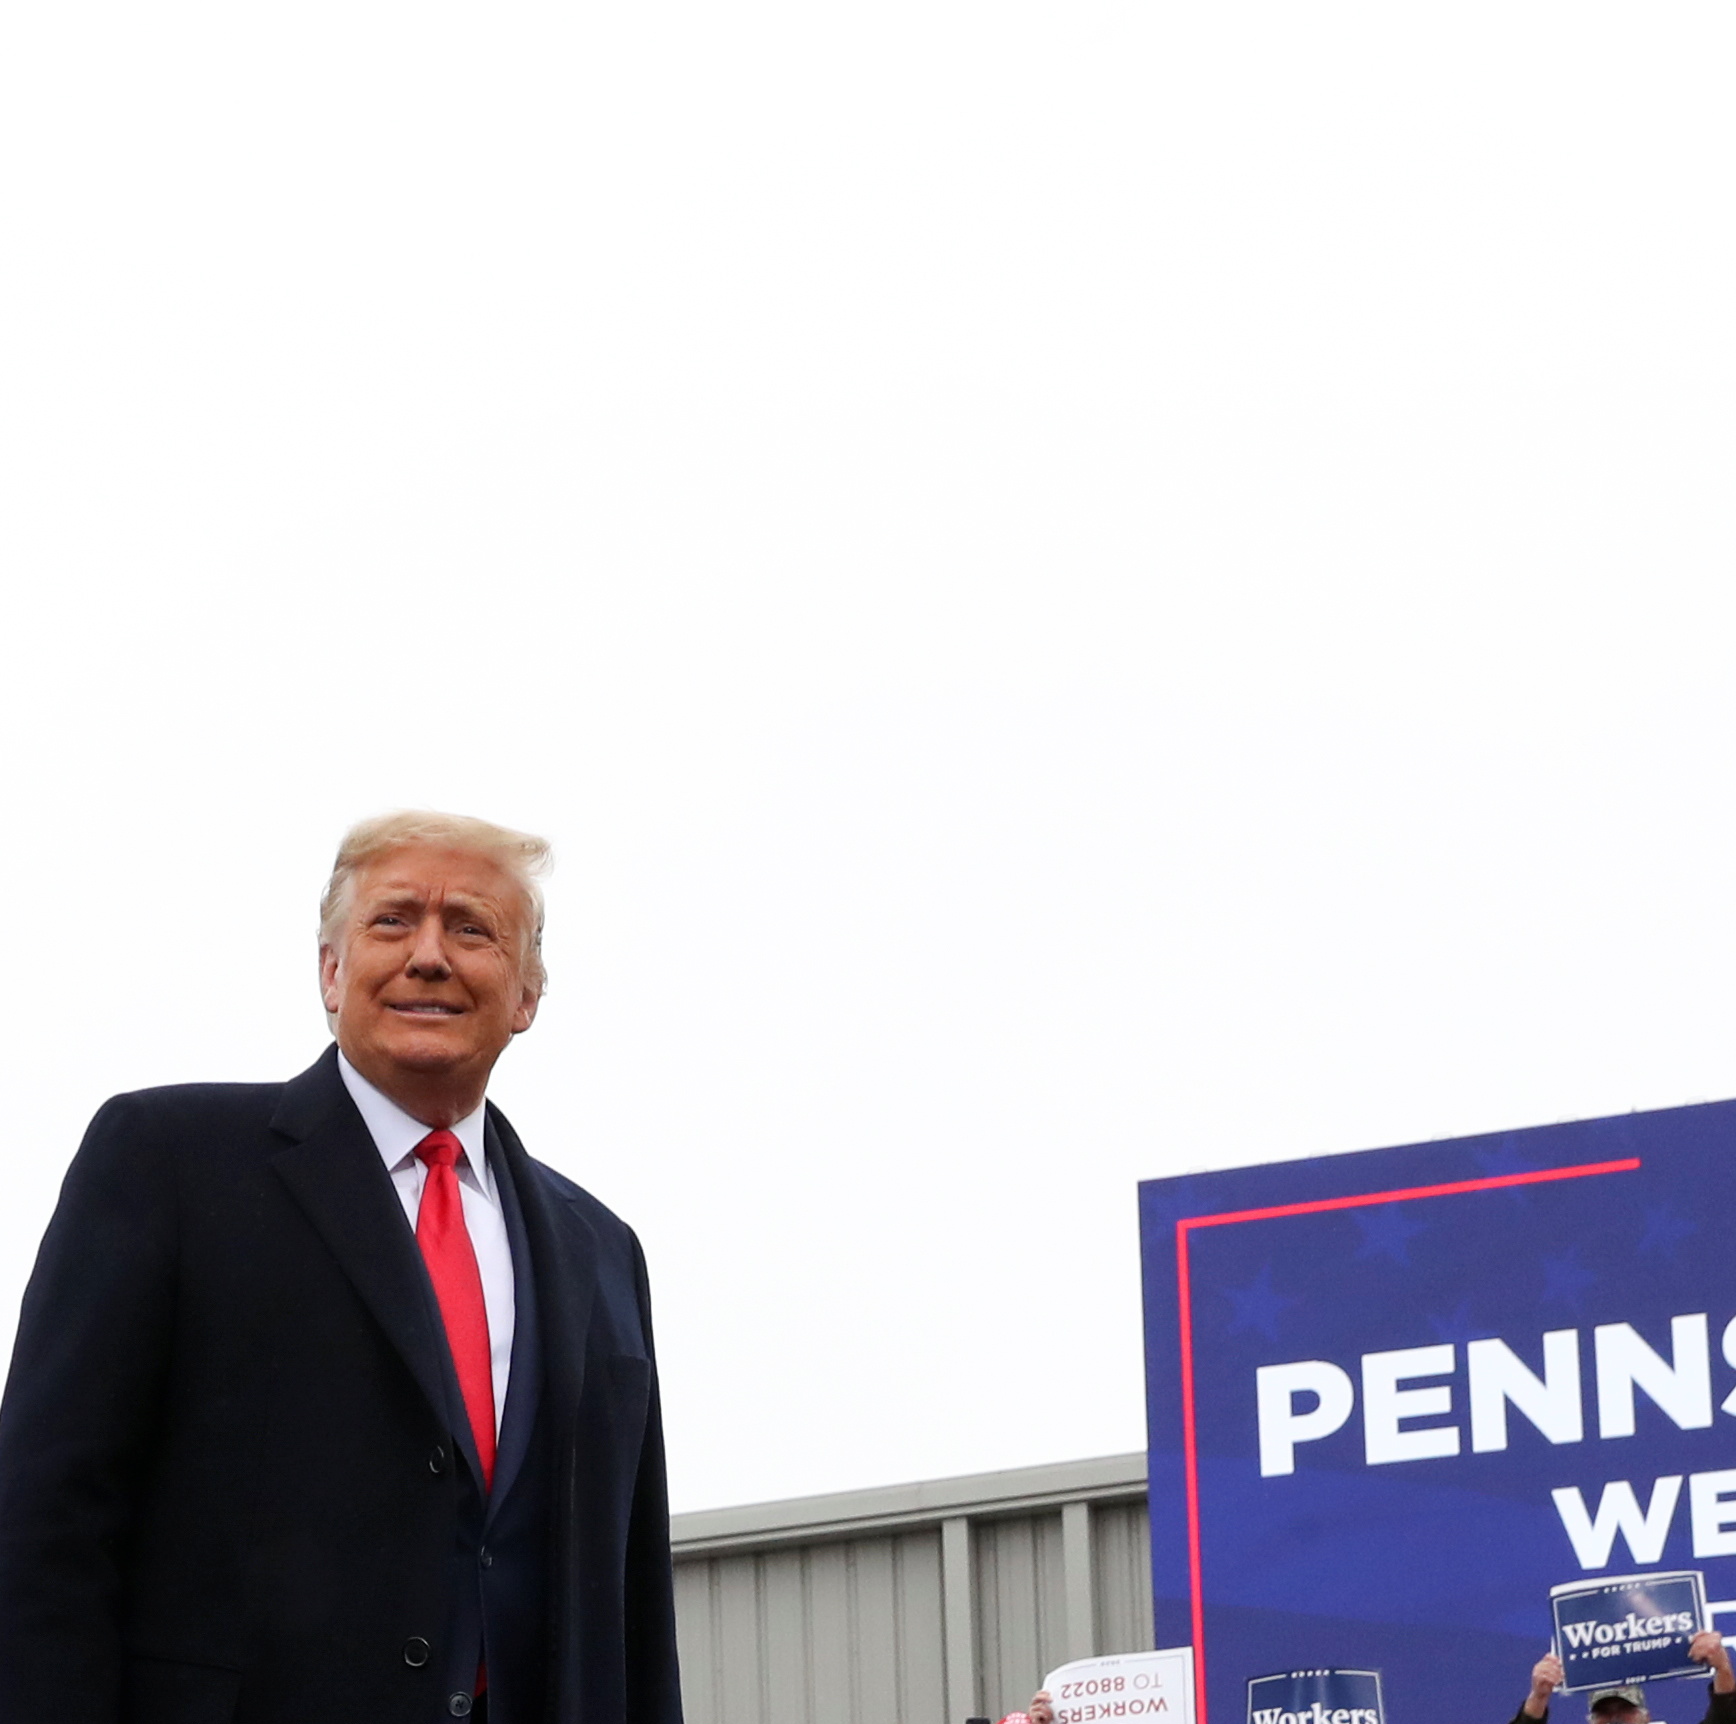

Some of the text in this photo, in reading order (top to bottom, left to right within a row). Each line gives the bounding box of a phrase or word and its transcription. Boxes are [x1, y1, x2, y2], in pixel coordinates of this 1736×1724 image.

[1562, 1611, 1694, 1648] Workers
[1592, 1637, 1671, 1660] FOR TRUMP
[1061, 1672, 1163, 1700] TO 88022
[1058, 1696, 1168, 1724] WORKERS
